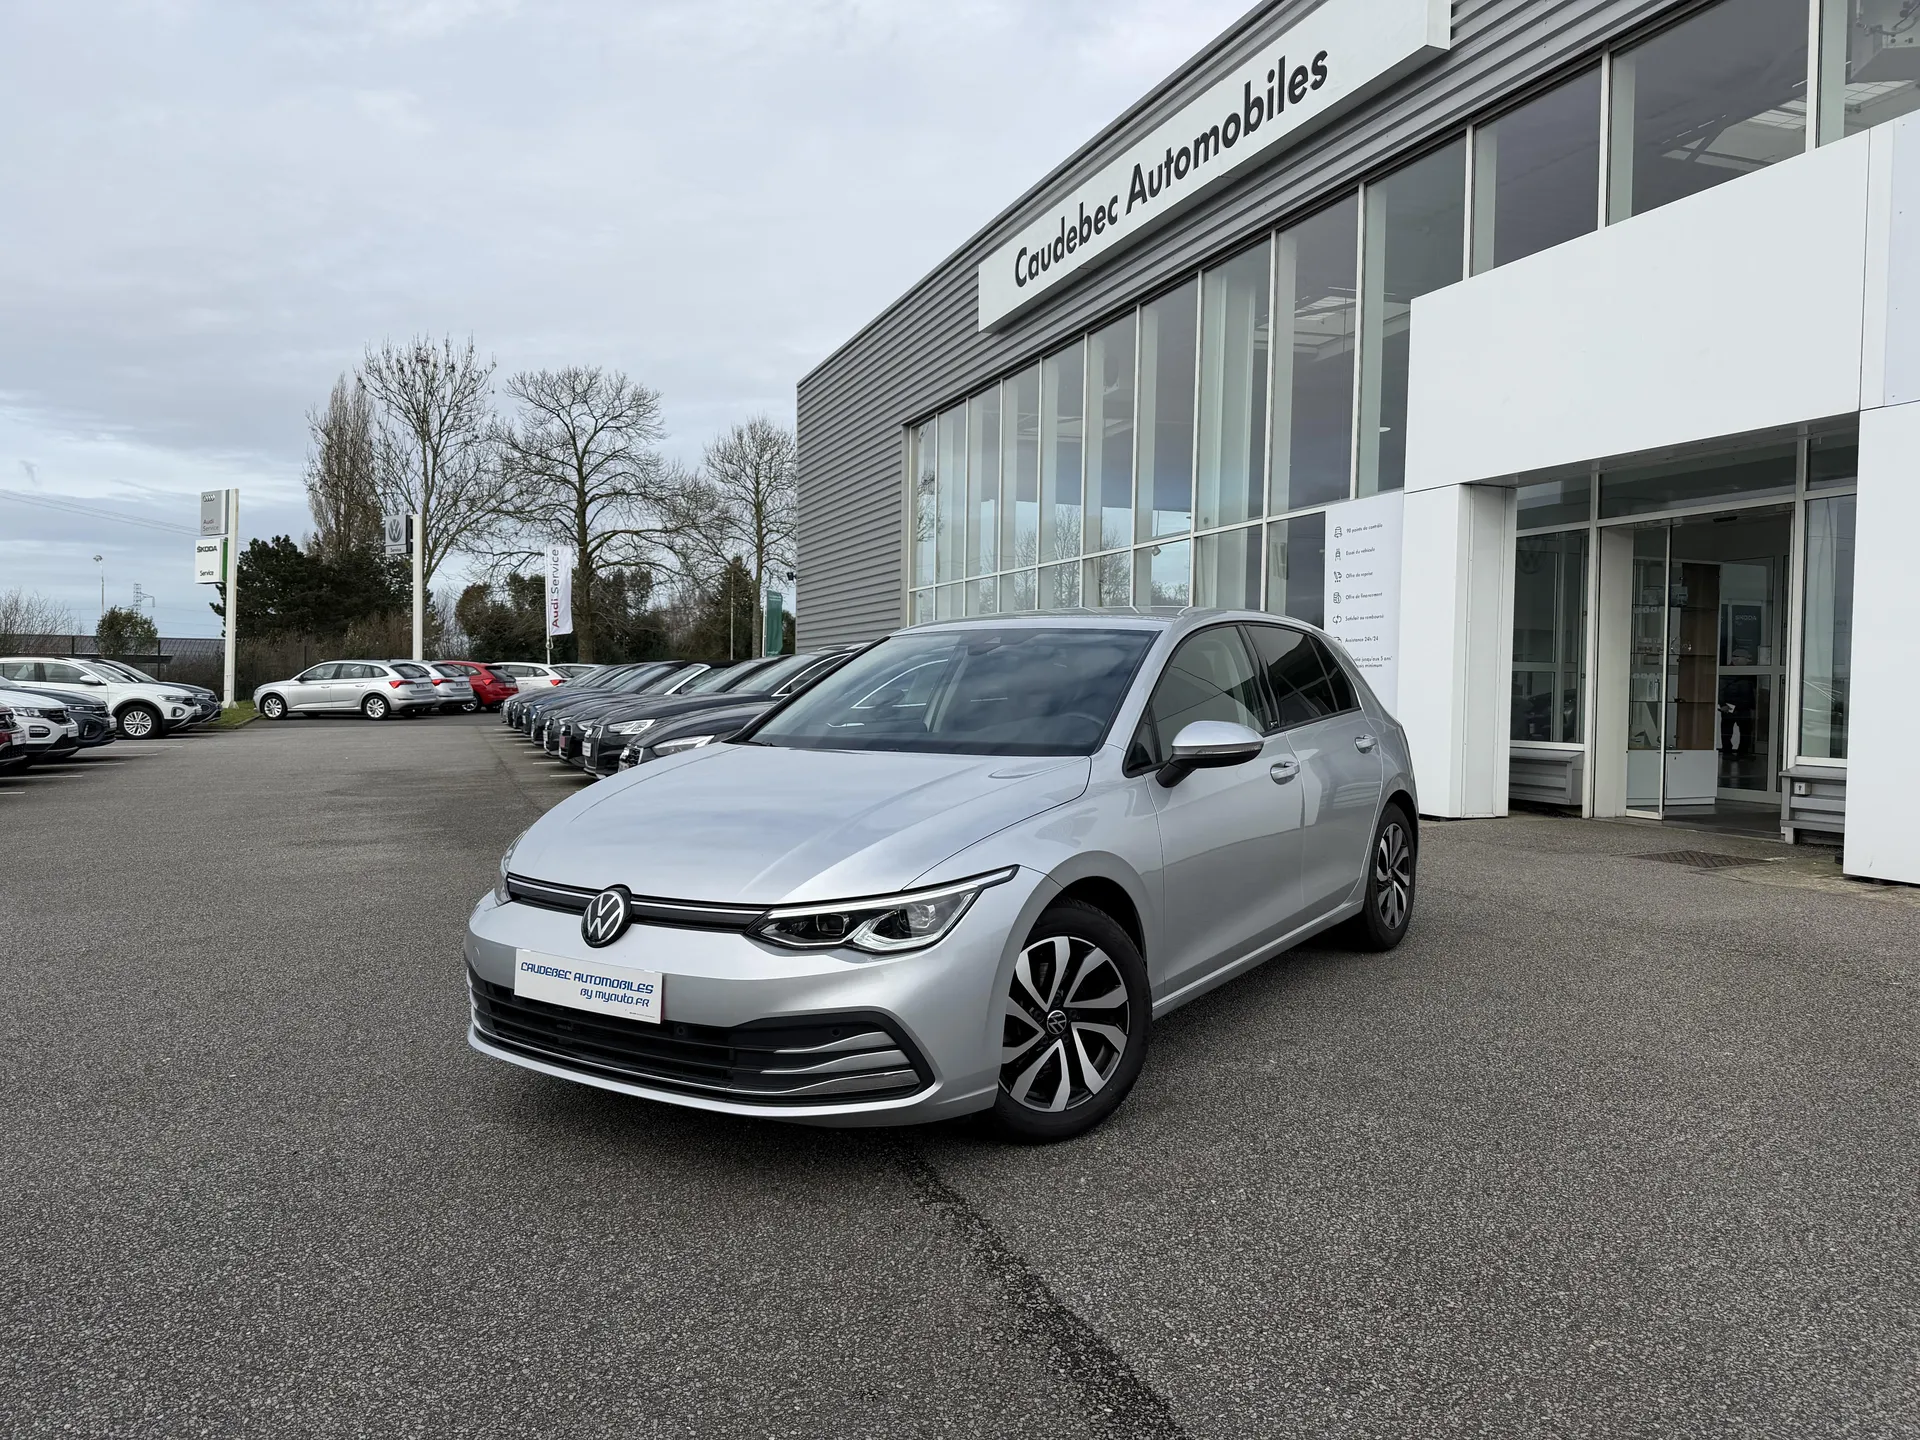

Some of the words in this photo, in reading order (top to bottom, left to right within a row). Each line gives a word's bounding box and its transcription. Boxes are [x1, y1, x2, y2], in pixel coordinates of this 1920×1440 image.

[1015, 195, 1119, 288] Caudebec
[1125, 49, 1329, 216] Automobiles
[551, 549, 560, 594] Service
[551, 599, 560, 628] Audi
[520, 962, 572, 981] CAUDEBEC
[574, 972, 654, 994] AUTOMOBILES
